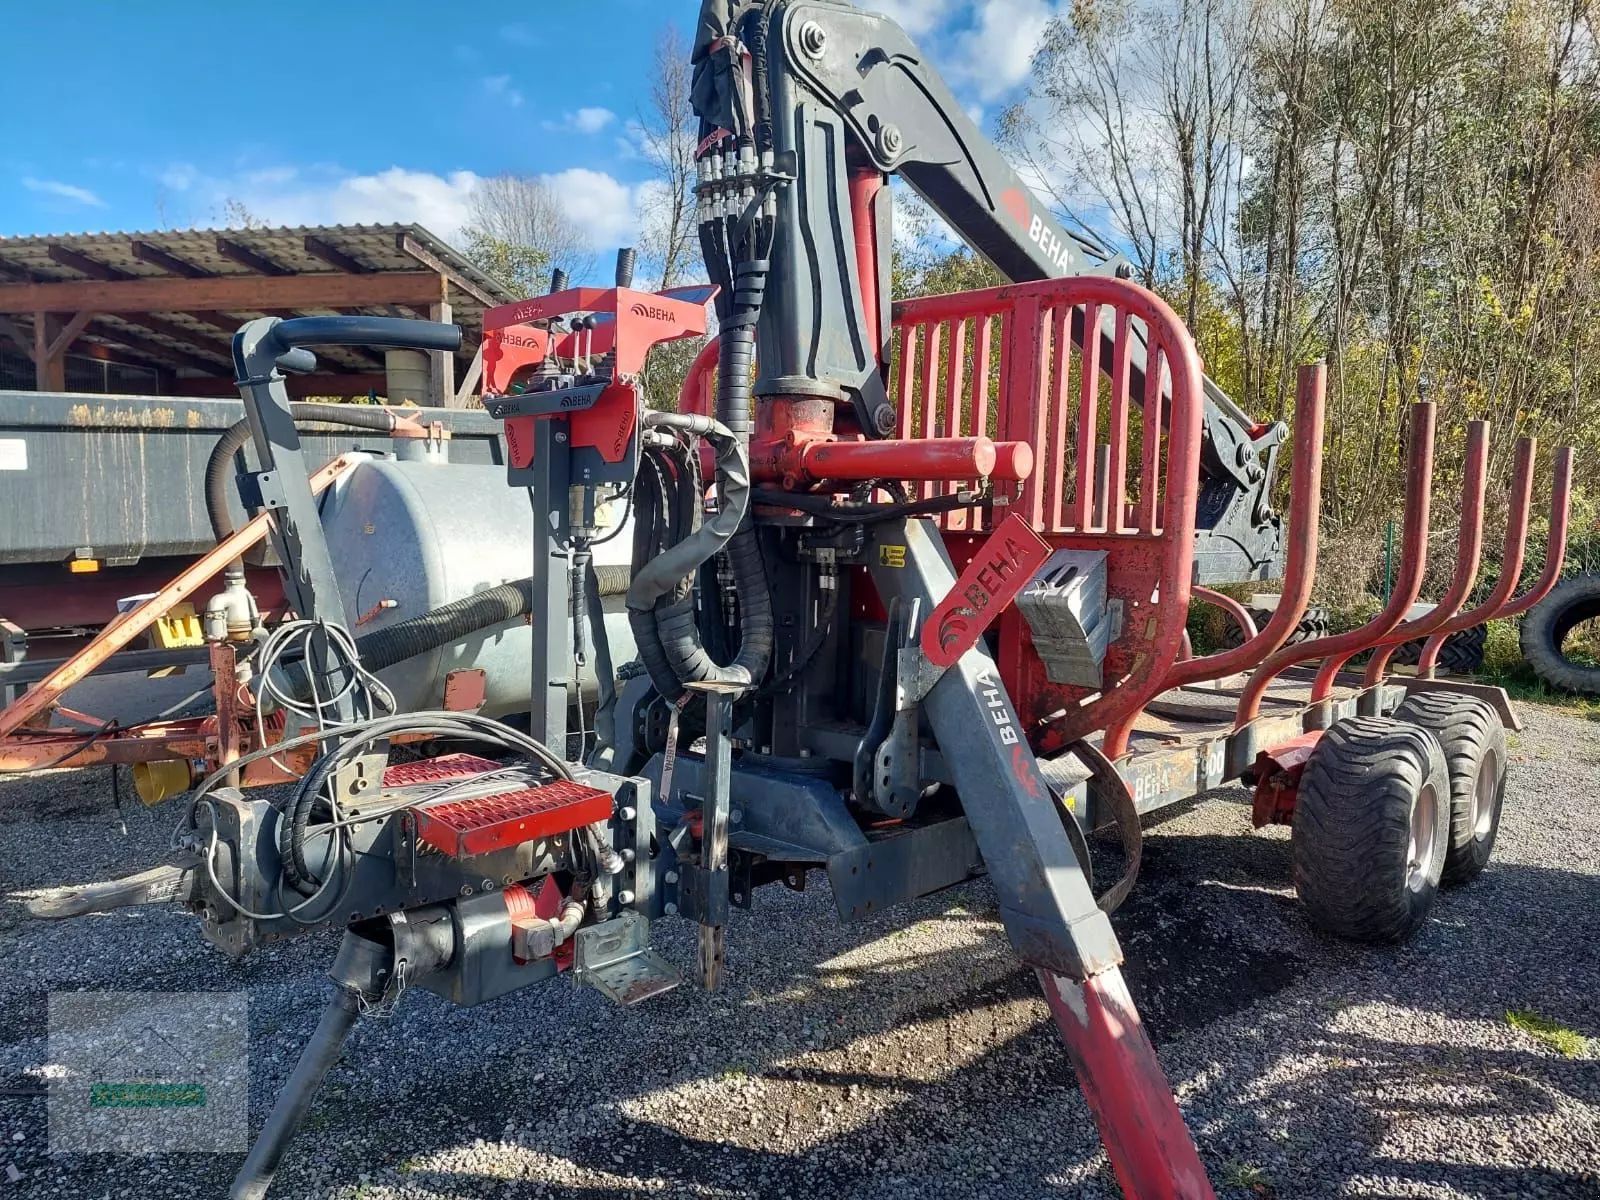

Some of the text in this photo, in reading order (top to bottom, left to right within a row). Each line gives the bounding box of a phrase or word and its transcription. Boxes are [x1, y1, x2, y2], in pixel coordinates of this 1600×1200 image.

[1029, 214, 1068, 275] BEHA
[649, 306, 676, 324] BEHA
[573, 393, 592, 407] BEHA
[618, 410, 631, 438] BEHA
[511, 439, 521, 464] BEHA
[964, 538, 1030, 612] BEHA
[977, 668, 1019, 745] BEHA
[664, 749, 675, 772] BEHA
[1135, 767, 1170, 802] BEHA
